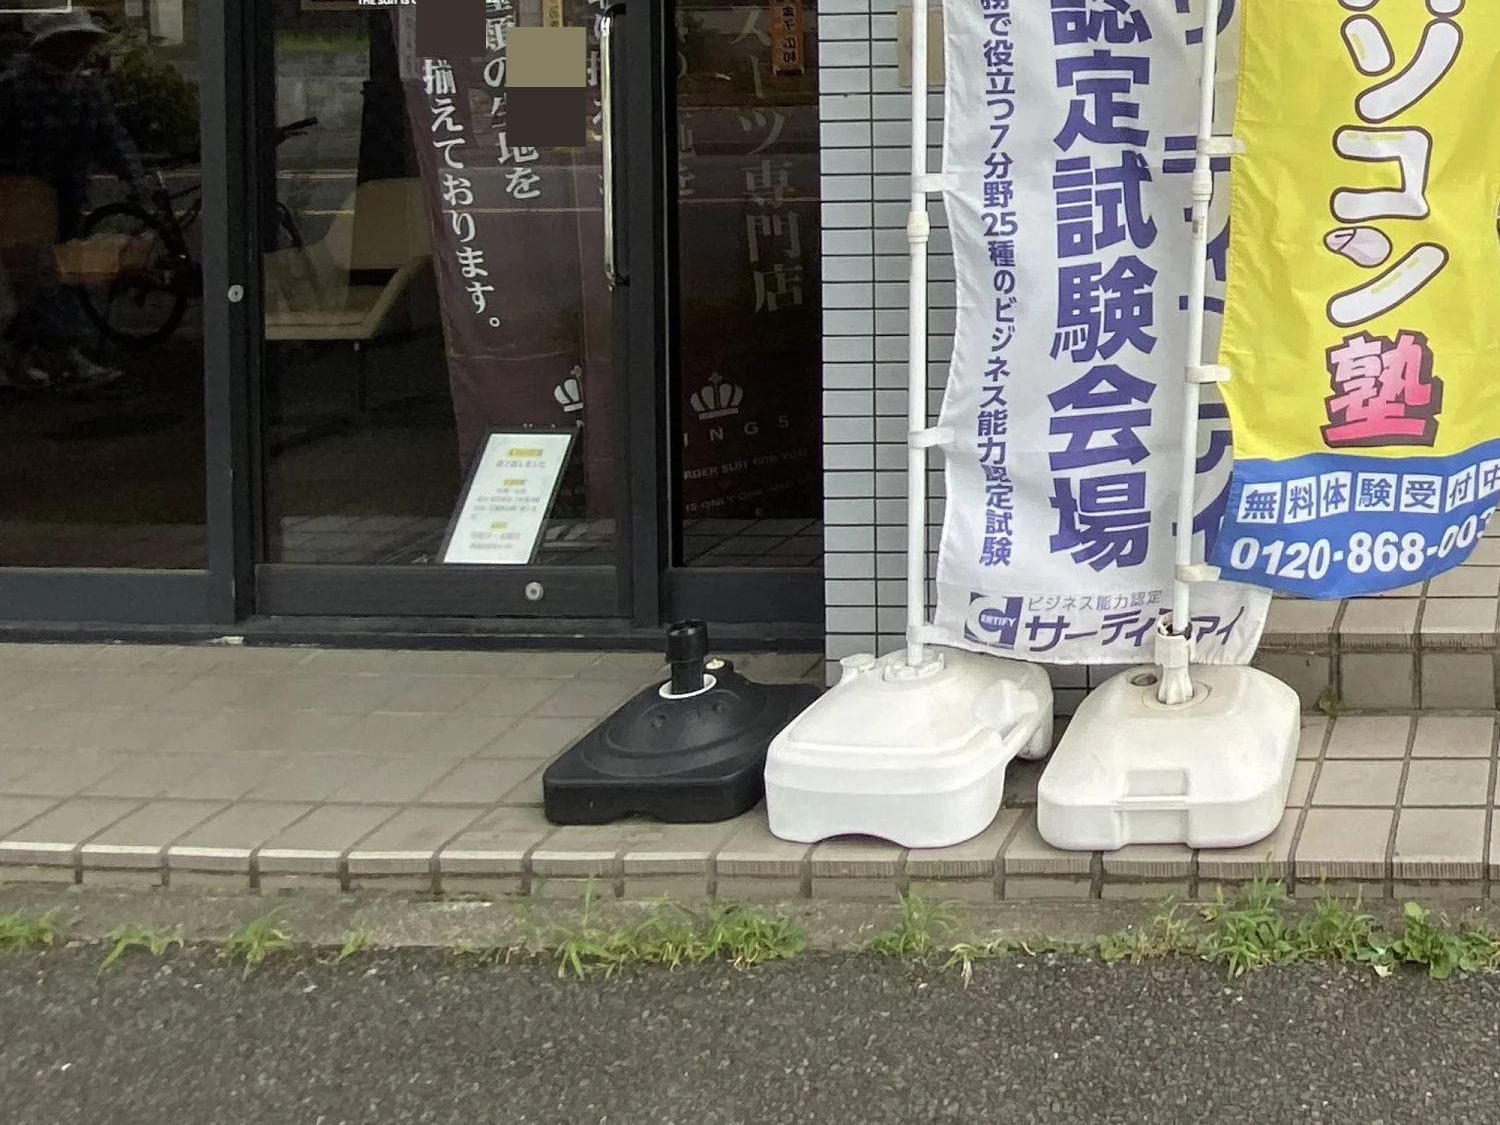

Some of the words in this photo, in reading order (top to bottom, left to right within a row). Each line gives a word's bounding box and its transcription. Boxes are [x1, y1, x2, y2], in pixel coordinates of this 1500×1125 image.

[1028, 589, 1163, 611] ビジネス能力認定
[1025, 606, 1245, 652] サーティァイ
